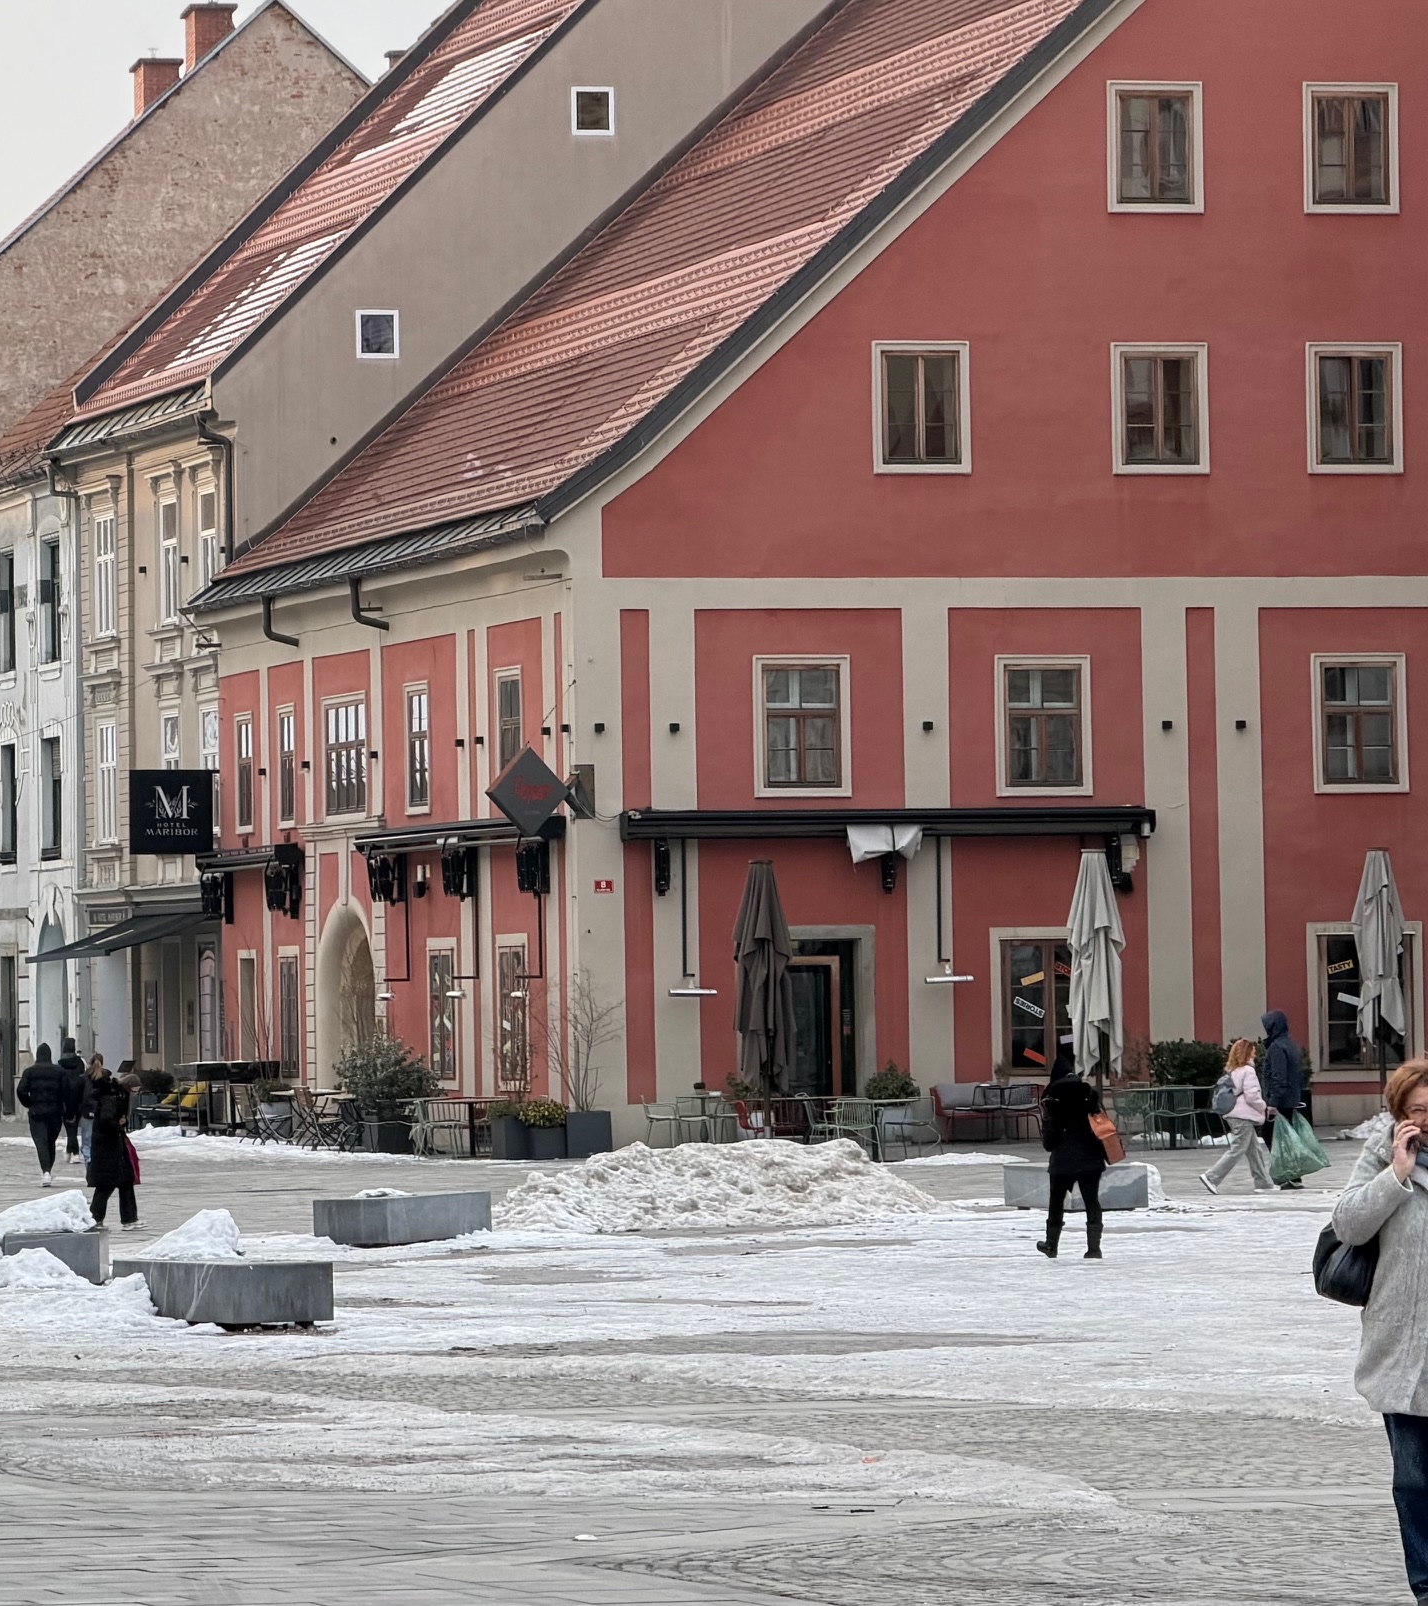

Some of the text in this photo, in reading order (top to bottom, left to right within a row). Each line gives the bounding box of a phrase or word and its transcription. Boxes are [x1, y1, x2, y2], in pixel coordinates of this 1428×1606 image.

[153, 785, 190, 819] M
[144, 828, 199, 837] MARIBOR
[1329, 962, 1351, 973] TASTY
[1015, 997, 1044, 1017] STORIES
